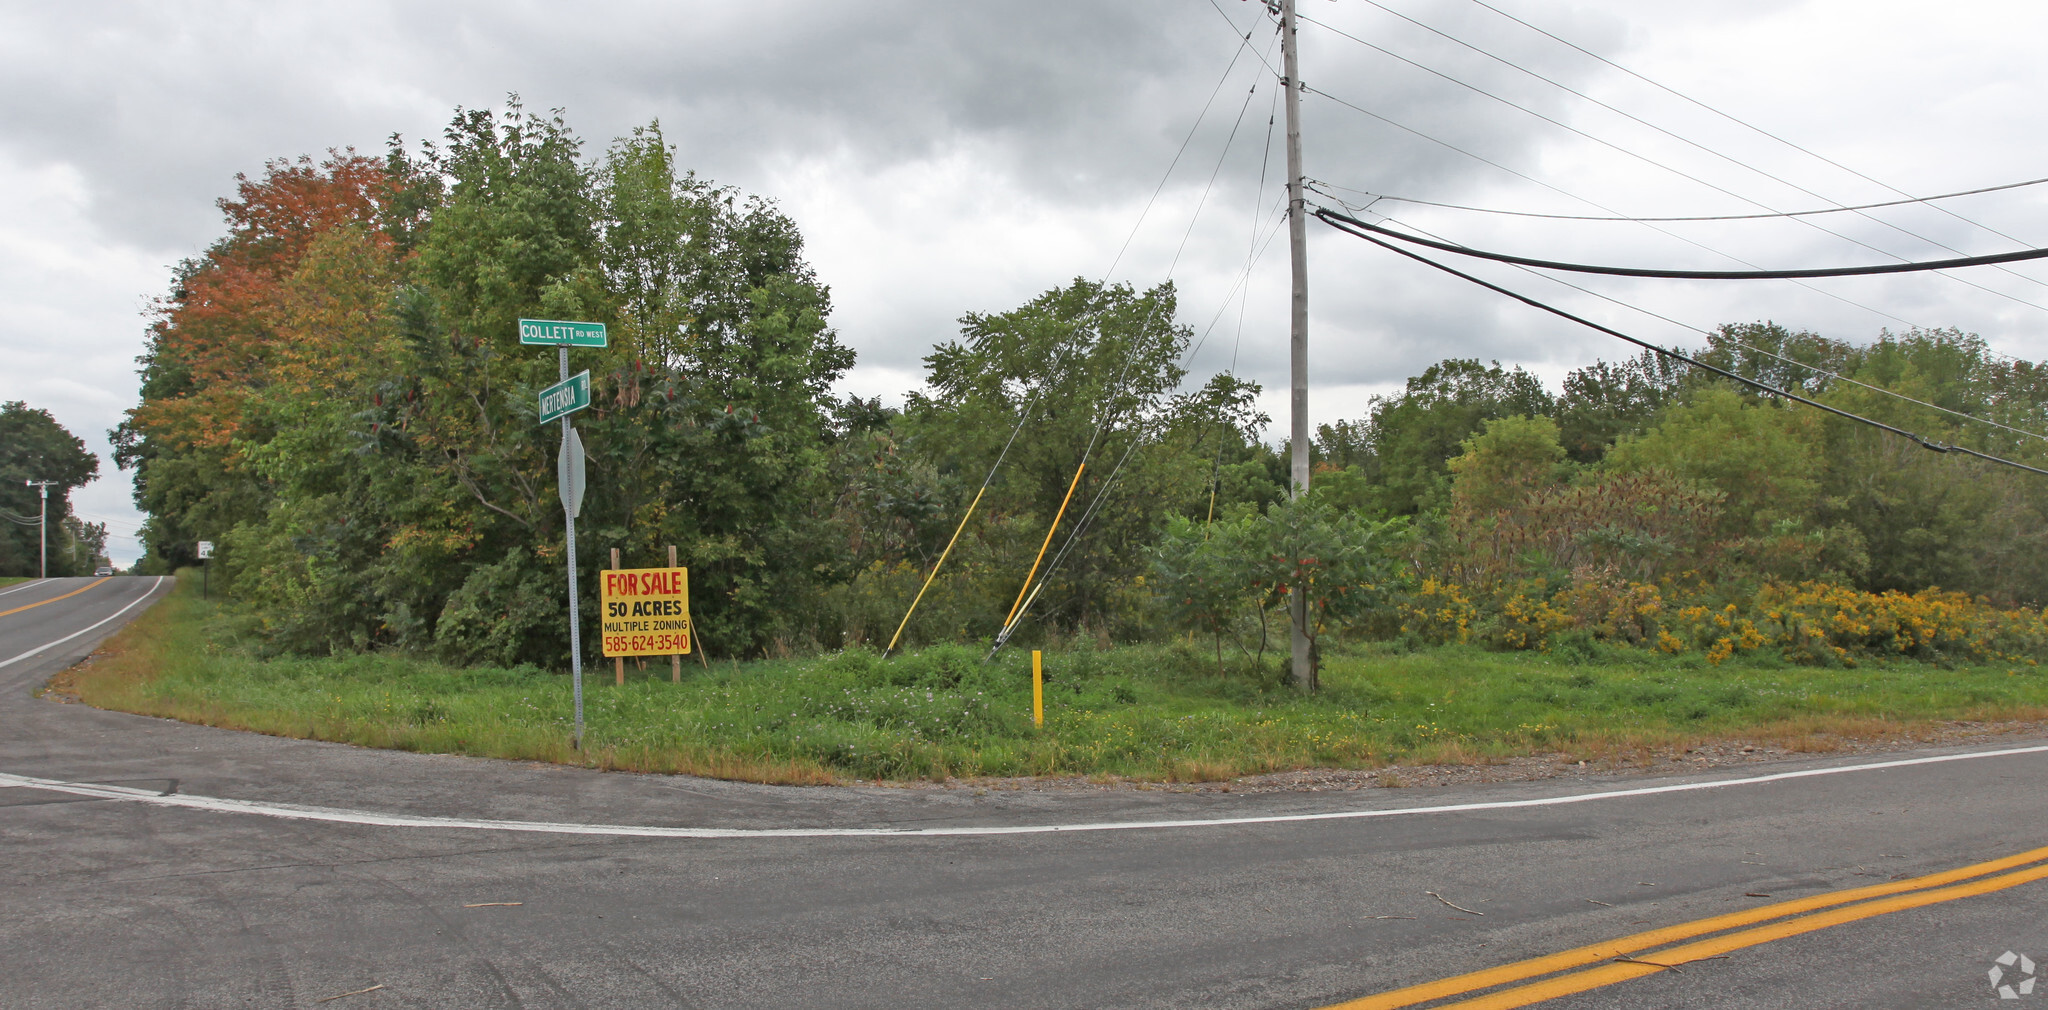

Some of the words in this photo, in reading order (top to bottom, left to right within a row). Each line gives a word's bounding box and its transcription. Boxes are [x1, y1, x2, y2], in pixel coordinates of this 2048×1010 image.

[522, 324, 575, 340] COLLETT
[587, 331, 603, 339] WEST
[542, 385, 576, 416] MERTENSIA
[607, 573, 638, 596] FOR
[641, 572, 681, 595] SALE
[608, 602, 628, 617] 50
[632, 600, 682, 616] ACRES
[605, 621, 649, 632] MULTIPLE
[653, 620, 687, 631] ZONING
[605, 634, 688, 652] 585-624-3540
